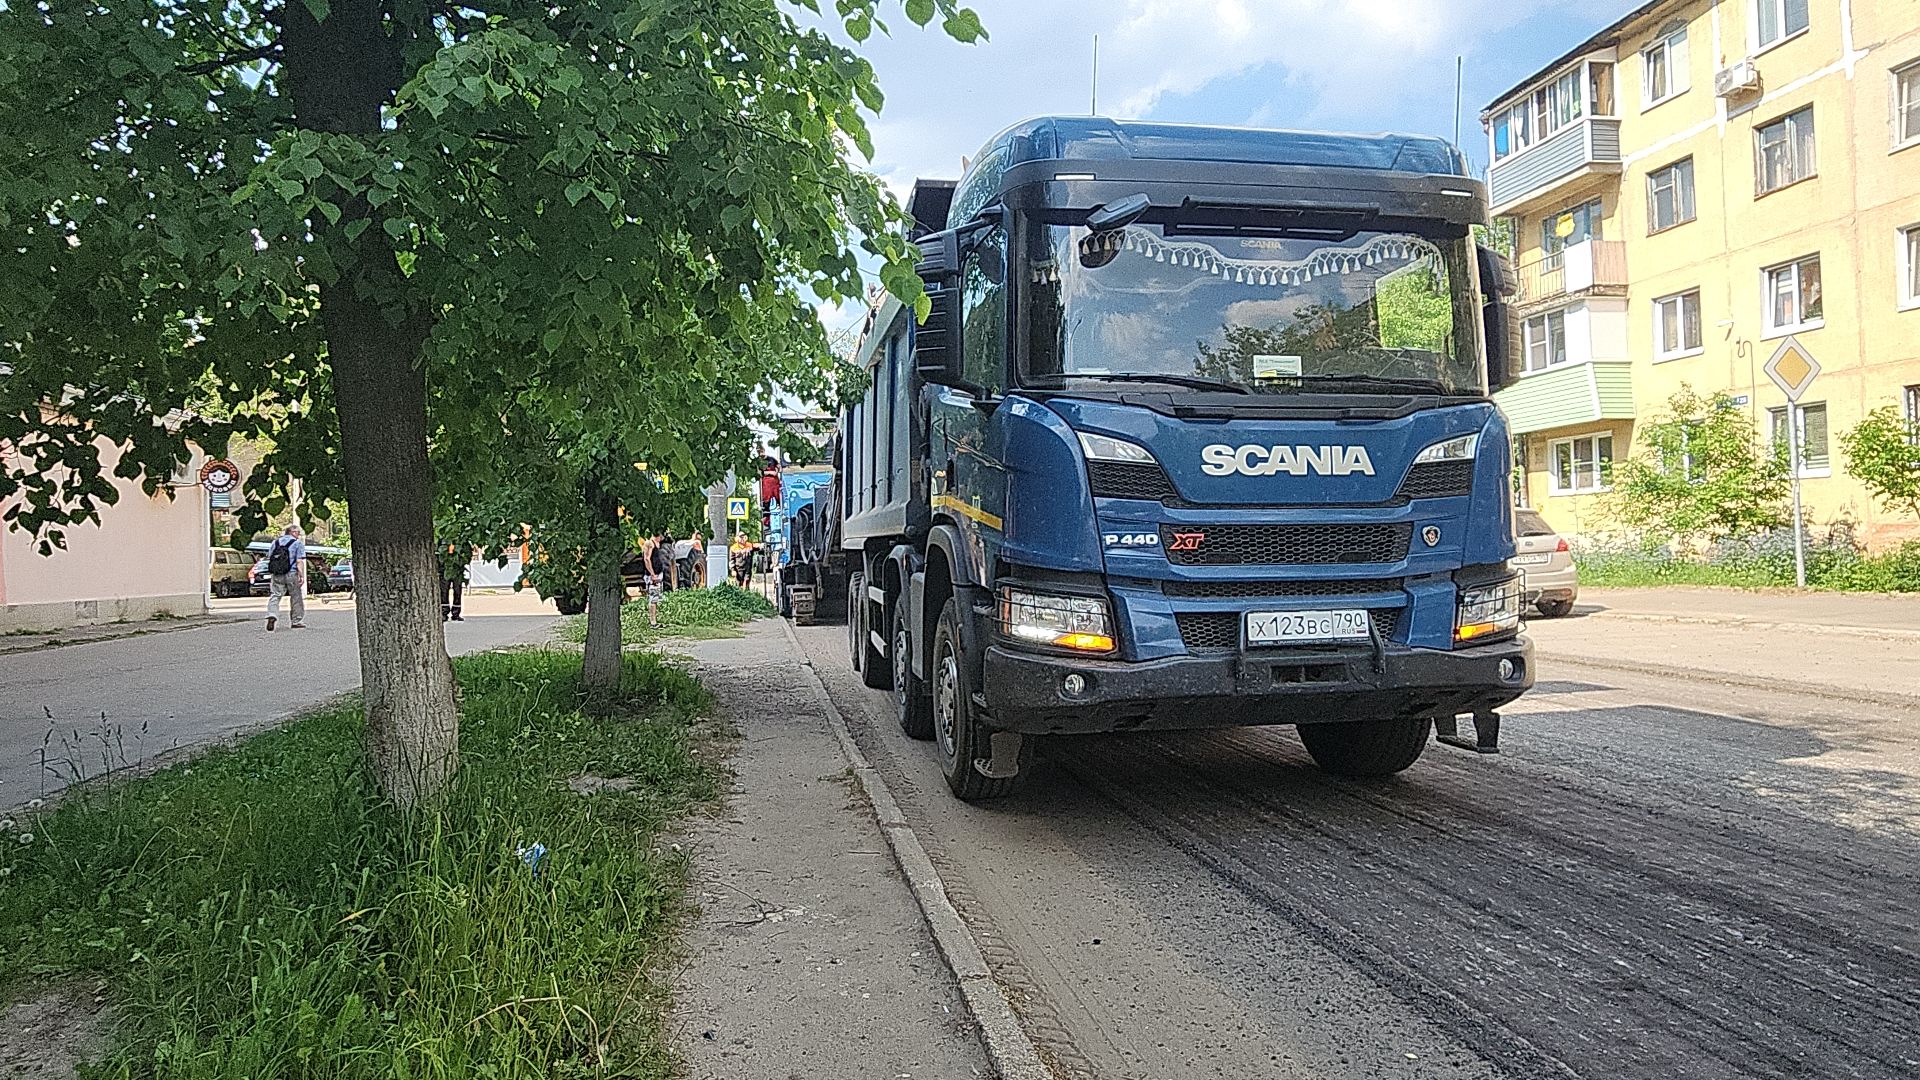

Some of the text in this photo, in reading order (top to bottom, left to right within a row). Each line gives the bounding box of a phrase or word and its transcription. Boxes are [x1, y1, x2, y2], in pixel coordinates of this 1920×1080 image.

[1240, 239, 1282, 250] SCANIA
[1200, 444, 1376, 476] SCANIA
[1105, 533, 1159, 546] P 440
[1169, 533, 1205, 550] XT
[1334, 613, 1363, 629] 790
